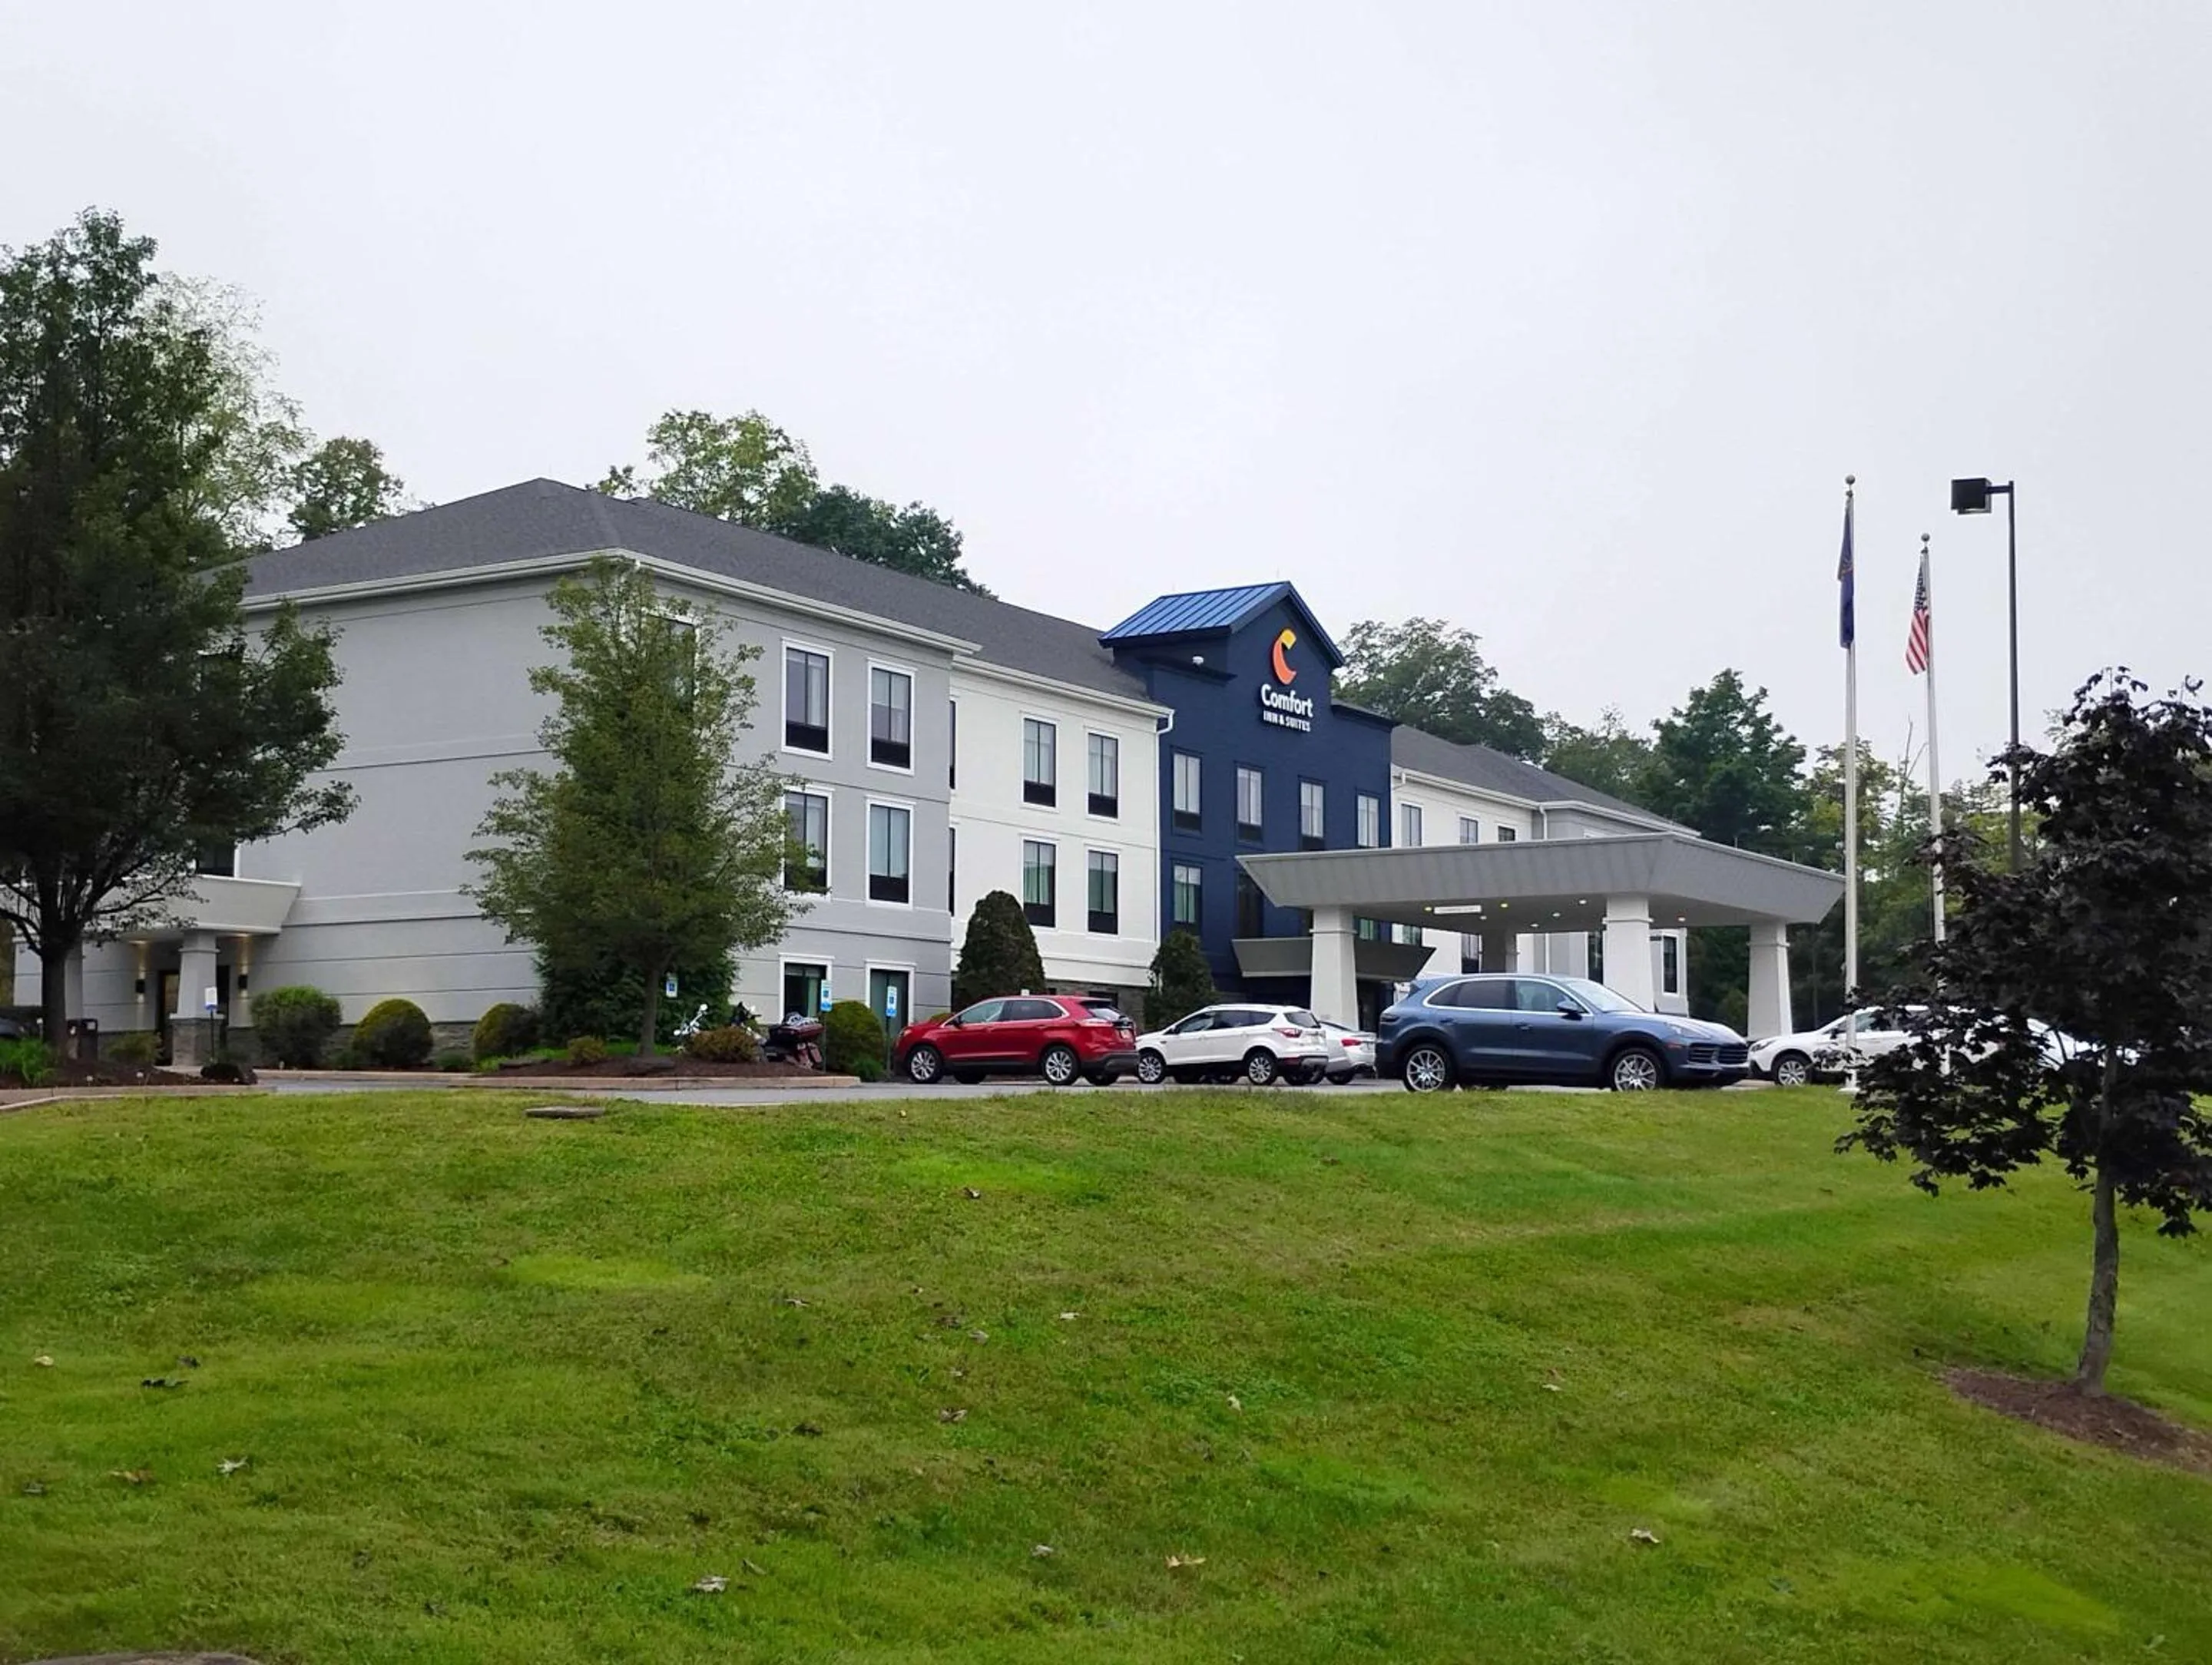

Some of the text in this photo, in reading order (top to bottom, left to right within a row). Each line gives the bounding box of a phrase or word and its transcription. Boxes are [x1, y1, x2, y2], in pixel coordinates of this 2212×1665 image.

[1261, 684, 1313, 717] Comfort
[1263, 710, 1278, 723] INN
[1286, 716, 1311, 732] SUITES
